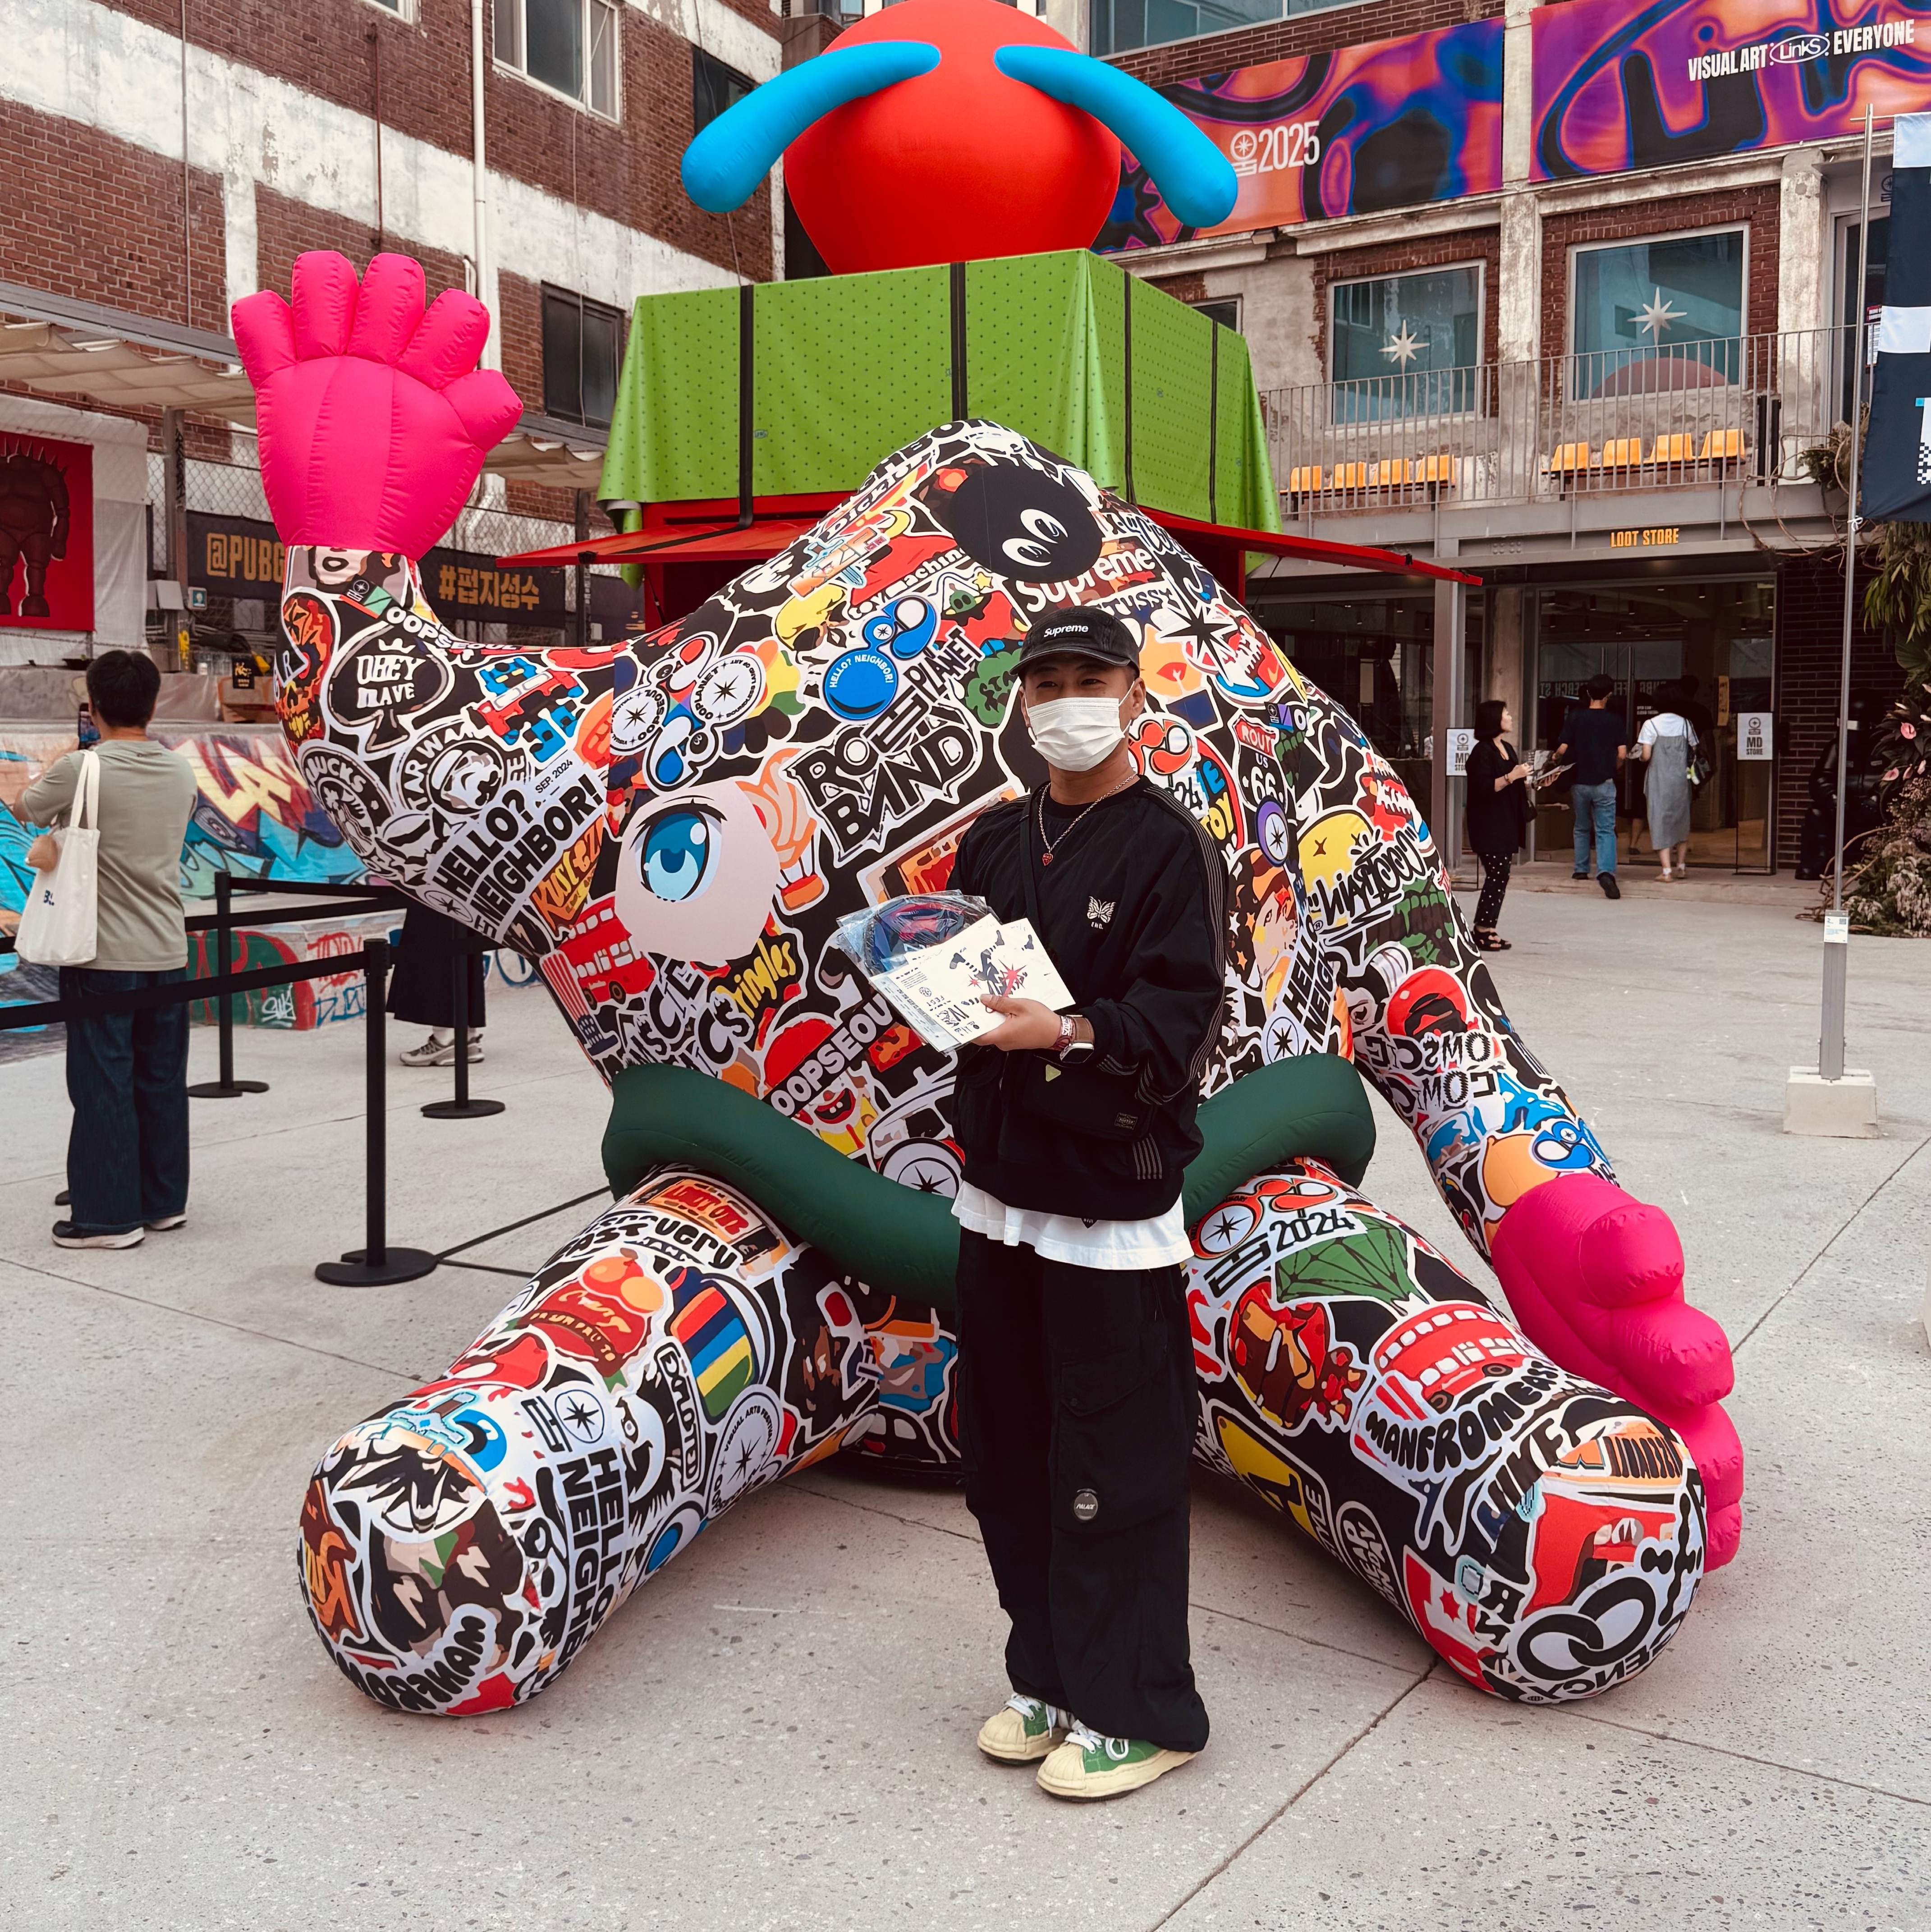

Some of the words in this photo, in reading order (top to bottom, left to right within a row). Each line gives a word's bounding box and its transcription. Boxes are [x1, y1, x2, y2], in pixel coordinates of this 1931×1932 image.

[1688, 51, 1739, 82] VISUAL
[1740, 44, 1768, 71] ART
[1833, 19, 1915, 55] EVERYONE
[1258, 120, 1320, 173] 2025
[206, 532, 284, 583] @PUBG
[1610, 531, 1639, 548] LOOT
[1642, 528, 1679, 546] STORE
[439, 564, 539, 611] #펍지성수
[386, 606, 519, 652] OOPSEOUL
[1044, 624, 1089, 638] Supreme
[356, 654, 426, 684] OBEY
[829, 658, 852, 688] HELLO?
[1255, 753, 1268, 768] US
[1746, 737, 1763, 748] MD
[535, 776, 553, 794] SEP.
[552, 758, 573, 780] 2024
[432, 789, 534, 901] HELLO?
[469, 773, 606, 927] NEIGHBOR!
[770, 993, 893, 1117] OOPSEOU
[1269, 1209, 1356, 1253] 2024
[588, 1447, 624, 1620] HELLO
